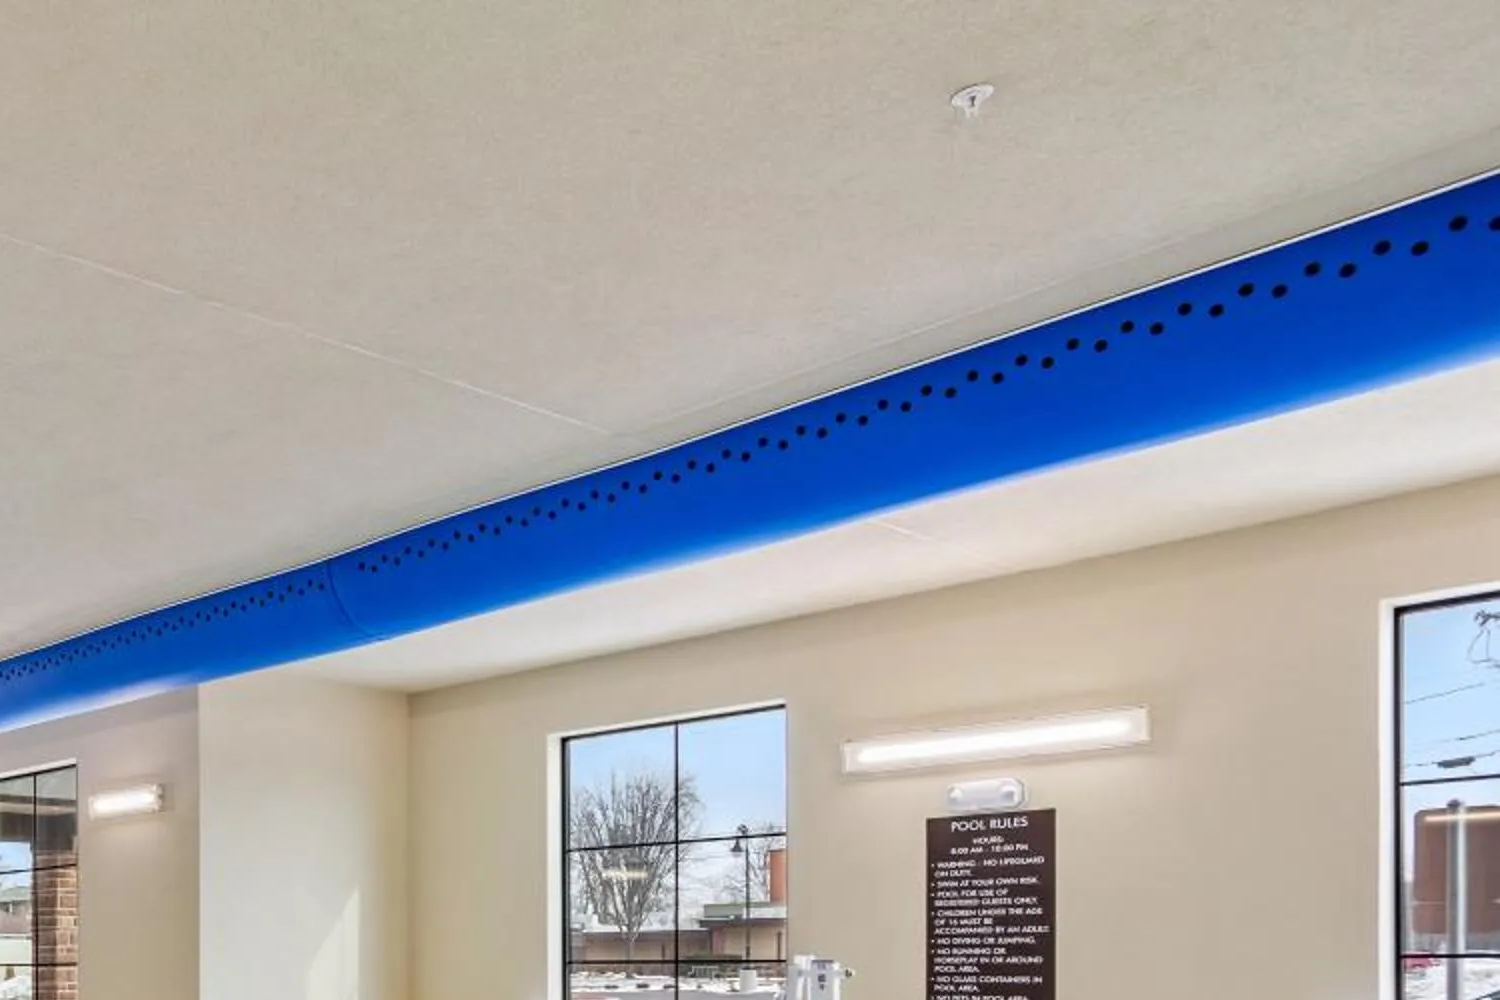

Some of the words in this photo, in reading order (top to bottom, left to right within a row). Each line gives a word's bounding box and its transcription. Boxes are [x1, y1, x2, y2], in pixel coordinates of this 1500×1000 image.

[951, 820, 986, 832] POOL
[990, 816, 1028, 829] RULES
[996, 888, 1008, 896] OF
